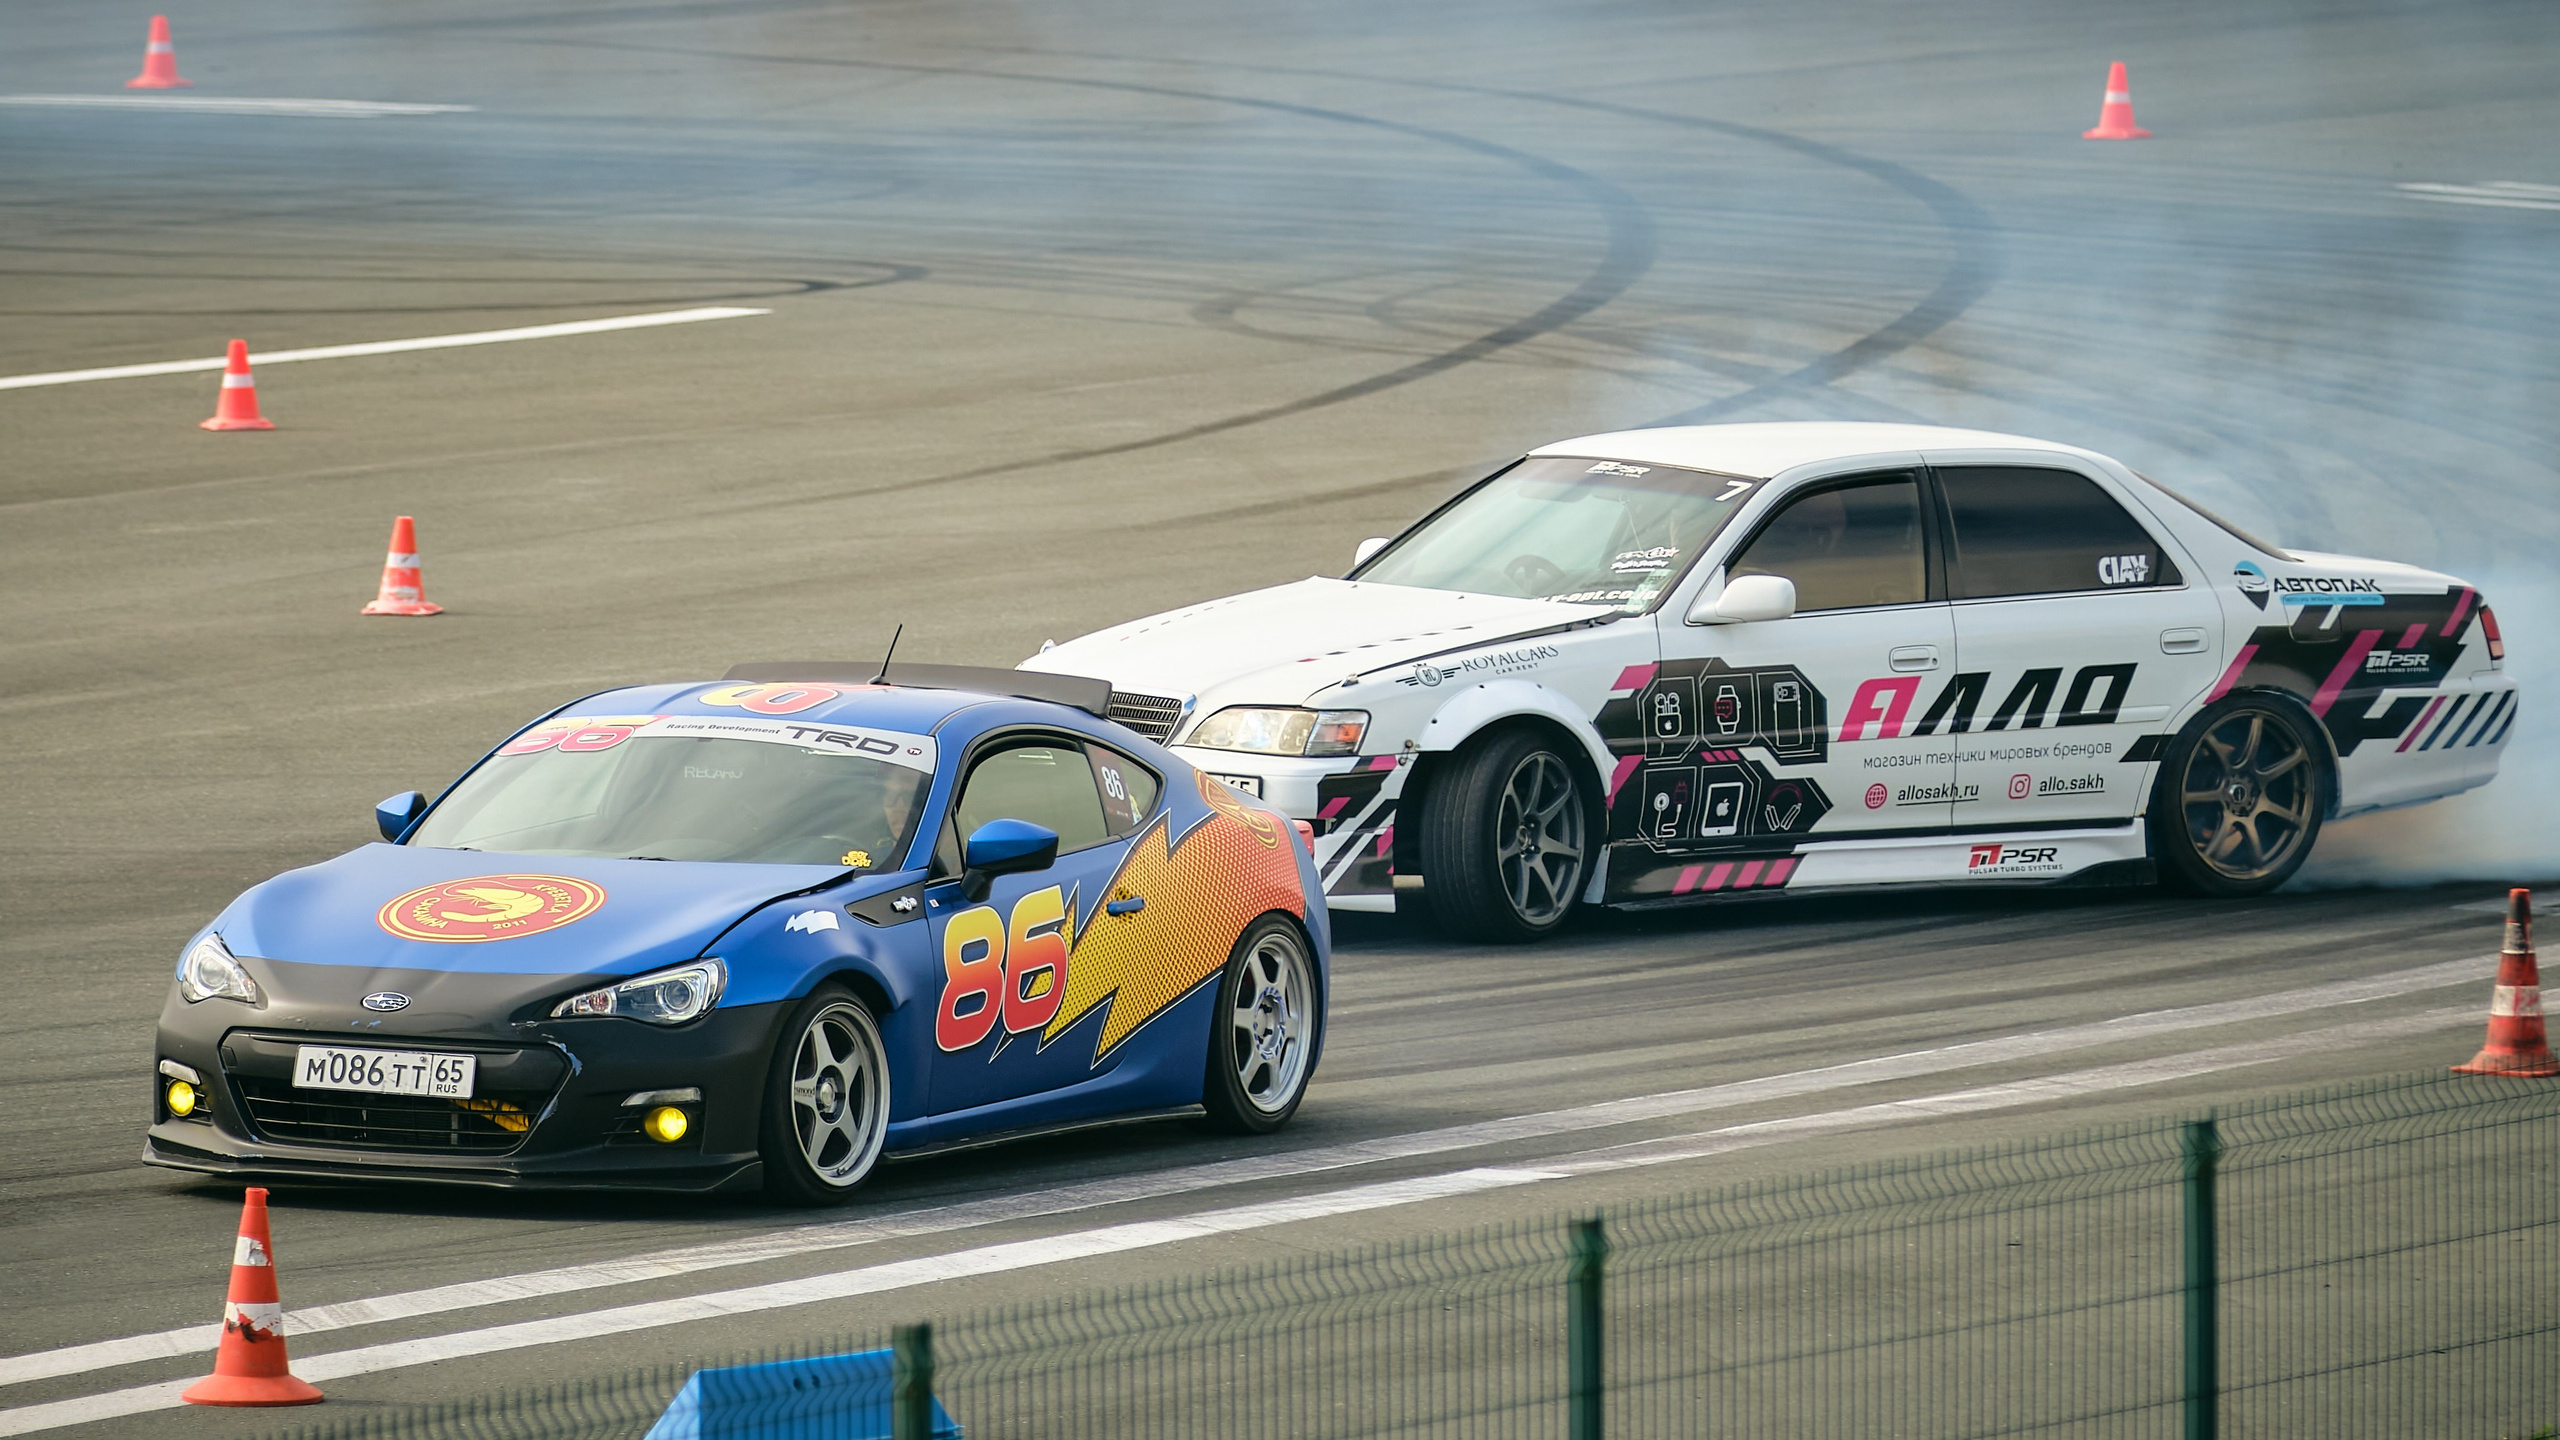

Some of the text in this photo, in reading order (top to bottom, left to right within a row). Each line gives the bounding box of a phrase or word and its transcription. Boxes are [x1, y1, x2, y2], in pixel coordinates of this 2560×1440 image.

[1715, 480, 1753, 502] 7
[2273, 577, 2383, 593] АВТОПАК
[1461, 644, 1559, 673] ROYALCARS
[1496, 662, 1539, 675] CAR RENT
[2388, 653, 2430, 667] PSR
[1837, 662, 2139, 742] АЛЛО
[497, 716, 660, 757] 86
[708, 724, 781, 735] Development
[785, 725, 900, 756] TRD
[1863, 741, 2113, 769] магазин техники мировых брендов
[1101, 766, 1125, 801] 86
[1897, 782, 1980, 802] allosakh.ru
[2038, 773, 2105, 793] allo.sakh
[2000, 847, 2058, 864] PSR
[1968, 863, 2064, 875] PULSAR TURBO SYSTEMS
[492, 919, 528, 930] 2011
[935, 884, 1069, 1053] 86
[435, 1058, 465, 1084] 65
[436, 1083, 458, 1094] RUS
